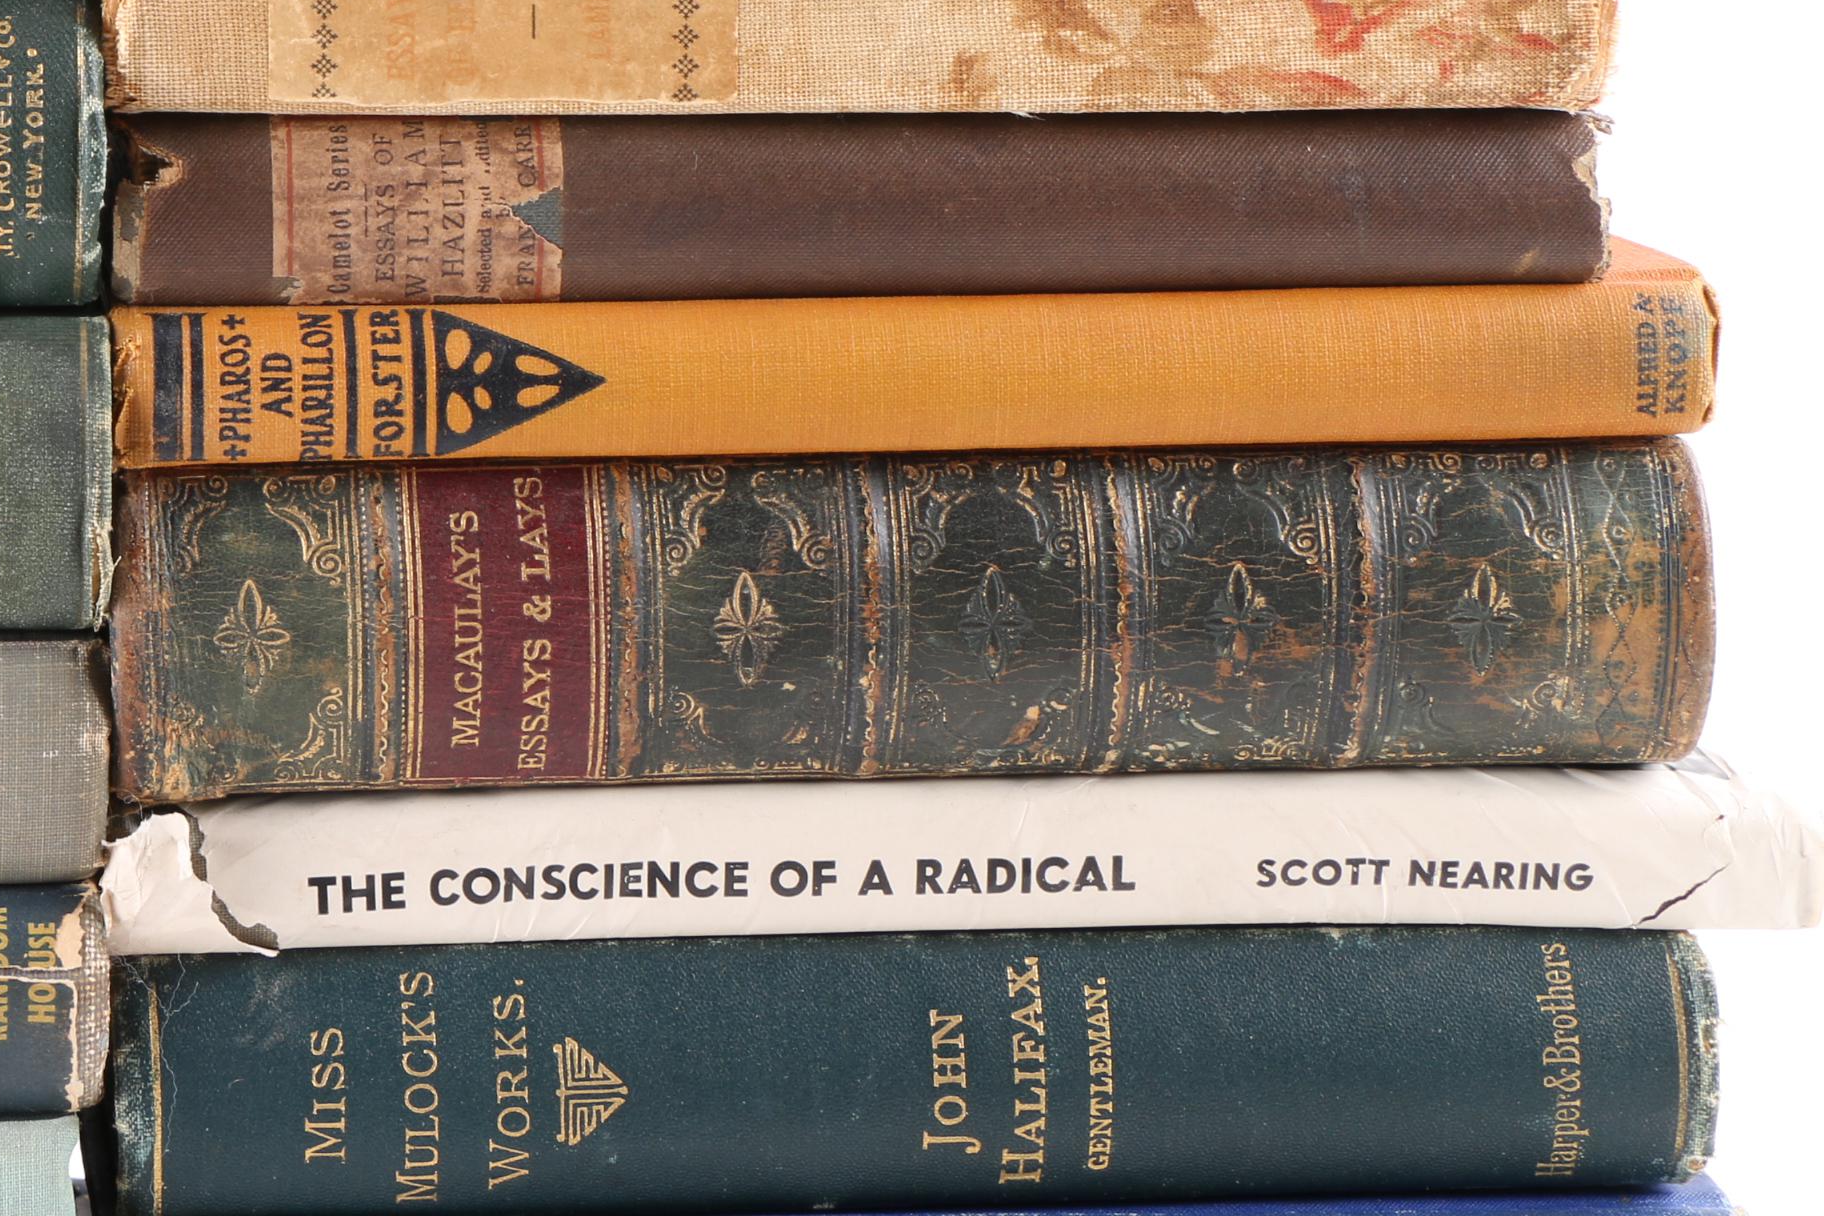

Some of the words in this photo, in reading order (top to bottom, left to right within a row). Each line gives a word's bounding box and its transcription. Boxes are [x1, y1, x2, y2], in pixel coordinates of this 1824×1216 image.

[25, 161, 43, 221] NEW
[326, 124, 351, 192] Series
[372, 133, 393, 166] OF
[327, 208, 352, 294] Camelot
[376, 184, 395, 283] ESSAYS
[402, 120, 429, 298] WILLIAM
[439, 135, 465, 279] HAZLITT
[517, 225, 536, 286] FRAN
[476, 228, 493, 293] Selected
[260, 352, 294, 418] AND
[297, 312, 334, 461] PHARILLON
[369, 309, 405, 457] FORSTER
[1636, 321, 1658, 418] ALFRED
[1658, 297, 1688, 414] KNOPF
[513, 477, 551, 582] LAYS
[449, 509, 482, 748] MACAULAY'S
[523, 595, 552, 622] &
[517, 638, 552, 771] ESSAYS
[307, 872, 407, 915] THE
[429, 860, 749, 906] CONSCIENCE
[769, 859, 838, 898] OF
[857, 859, 894, 896] A
[915, 855, 1137, 895] RADICAL
[1256, 857, 1391, 888] SCOTT
[1407, 859, 1595, 891] NEARING
[28, 922, 57, 1024] HOUSE
[1536, 943, 1582, 1065] Brothers
[923, 1009, 982, 1154] JOHN
[1083, 977, 1113, 1170] GENTLEMAN.
[1543, 1068, 1581, 1093] &
[1535, 1093, 1590, 1176] Harper
